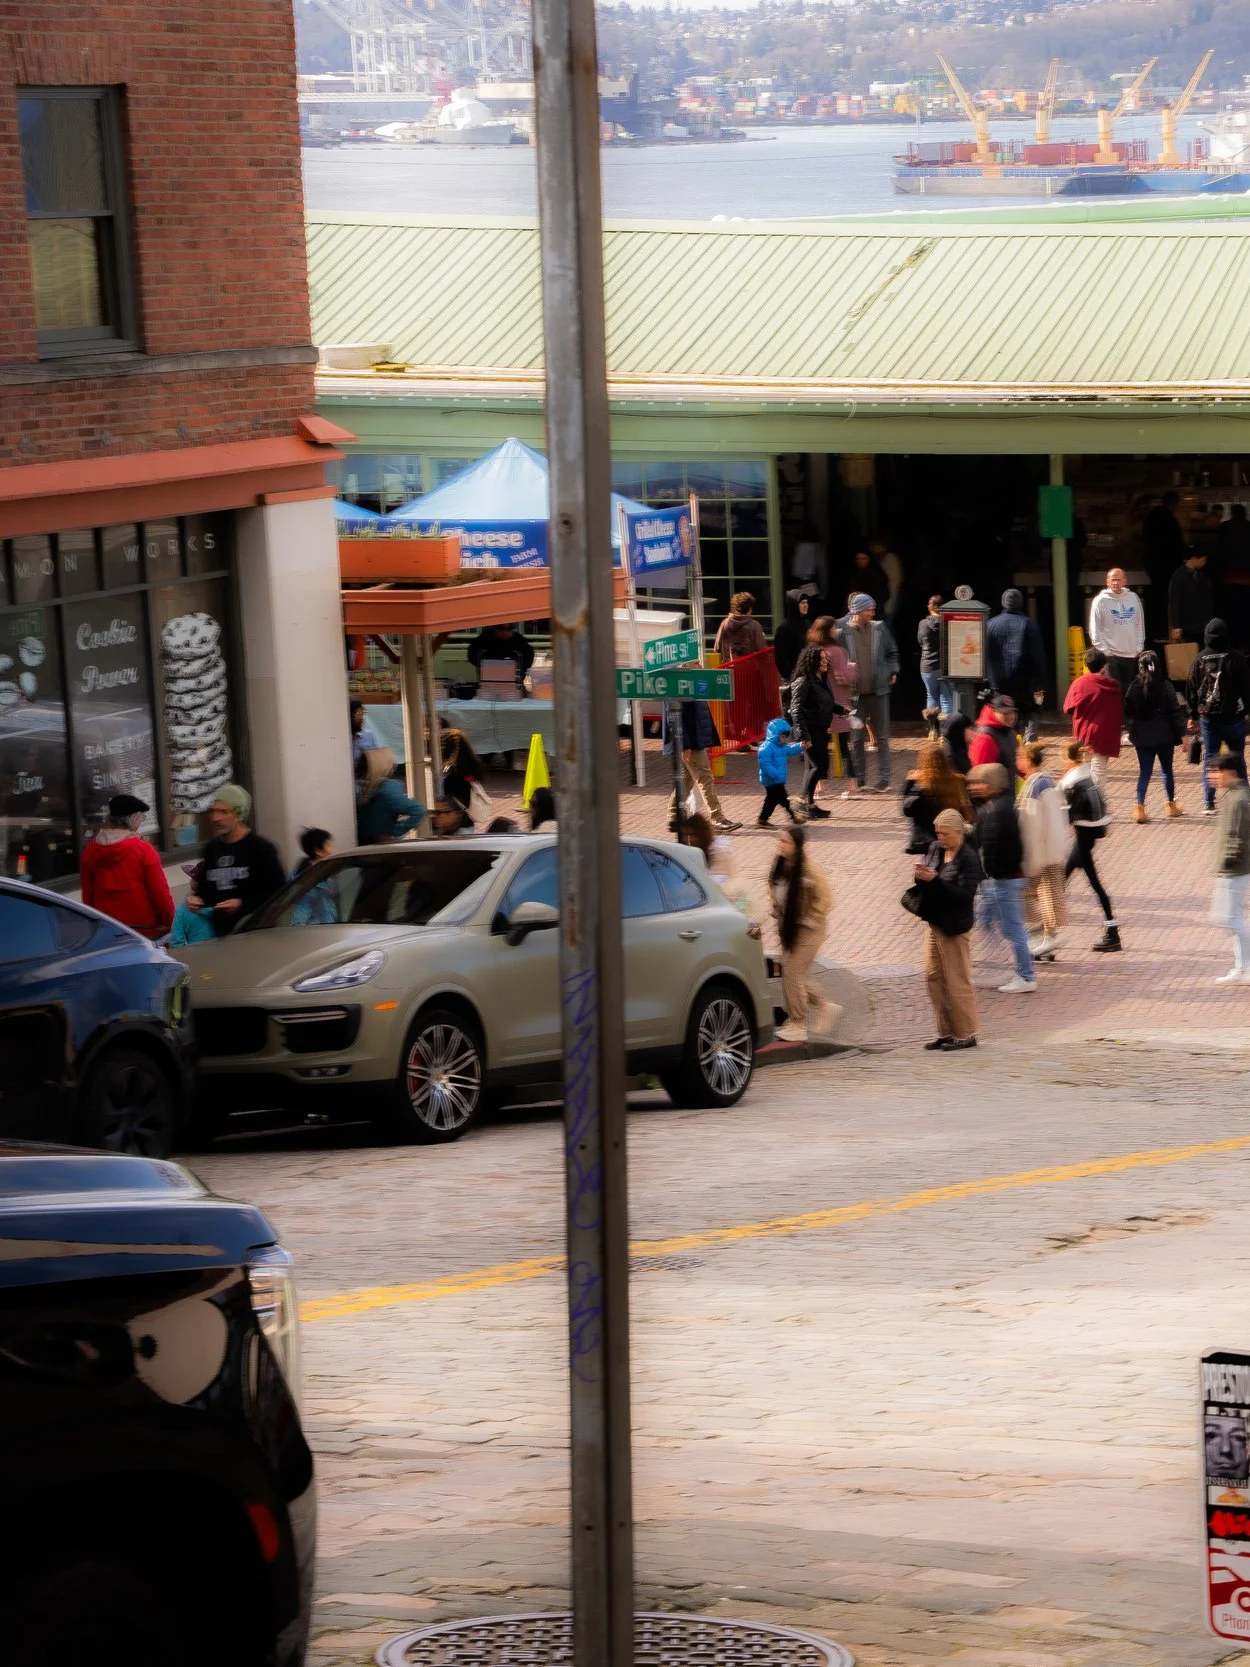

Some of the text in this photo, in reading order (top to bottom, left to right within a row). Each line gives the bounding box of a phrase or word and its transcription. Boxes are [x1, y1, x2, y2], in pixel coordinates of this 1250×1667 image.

[123, 533, 216, 562] WORKS
[655, 640, 678, 665] Pine
[620, 671, 695, 695] Pike Pl
